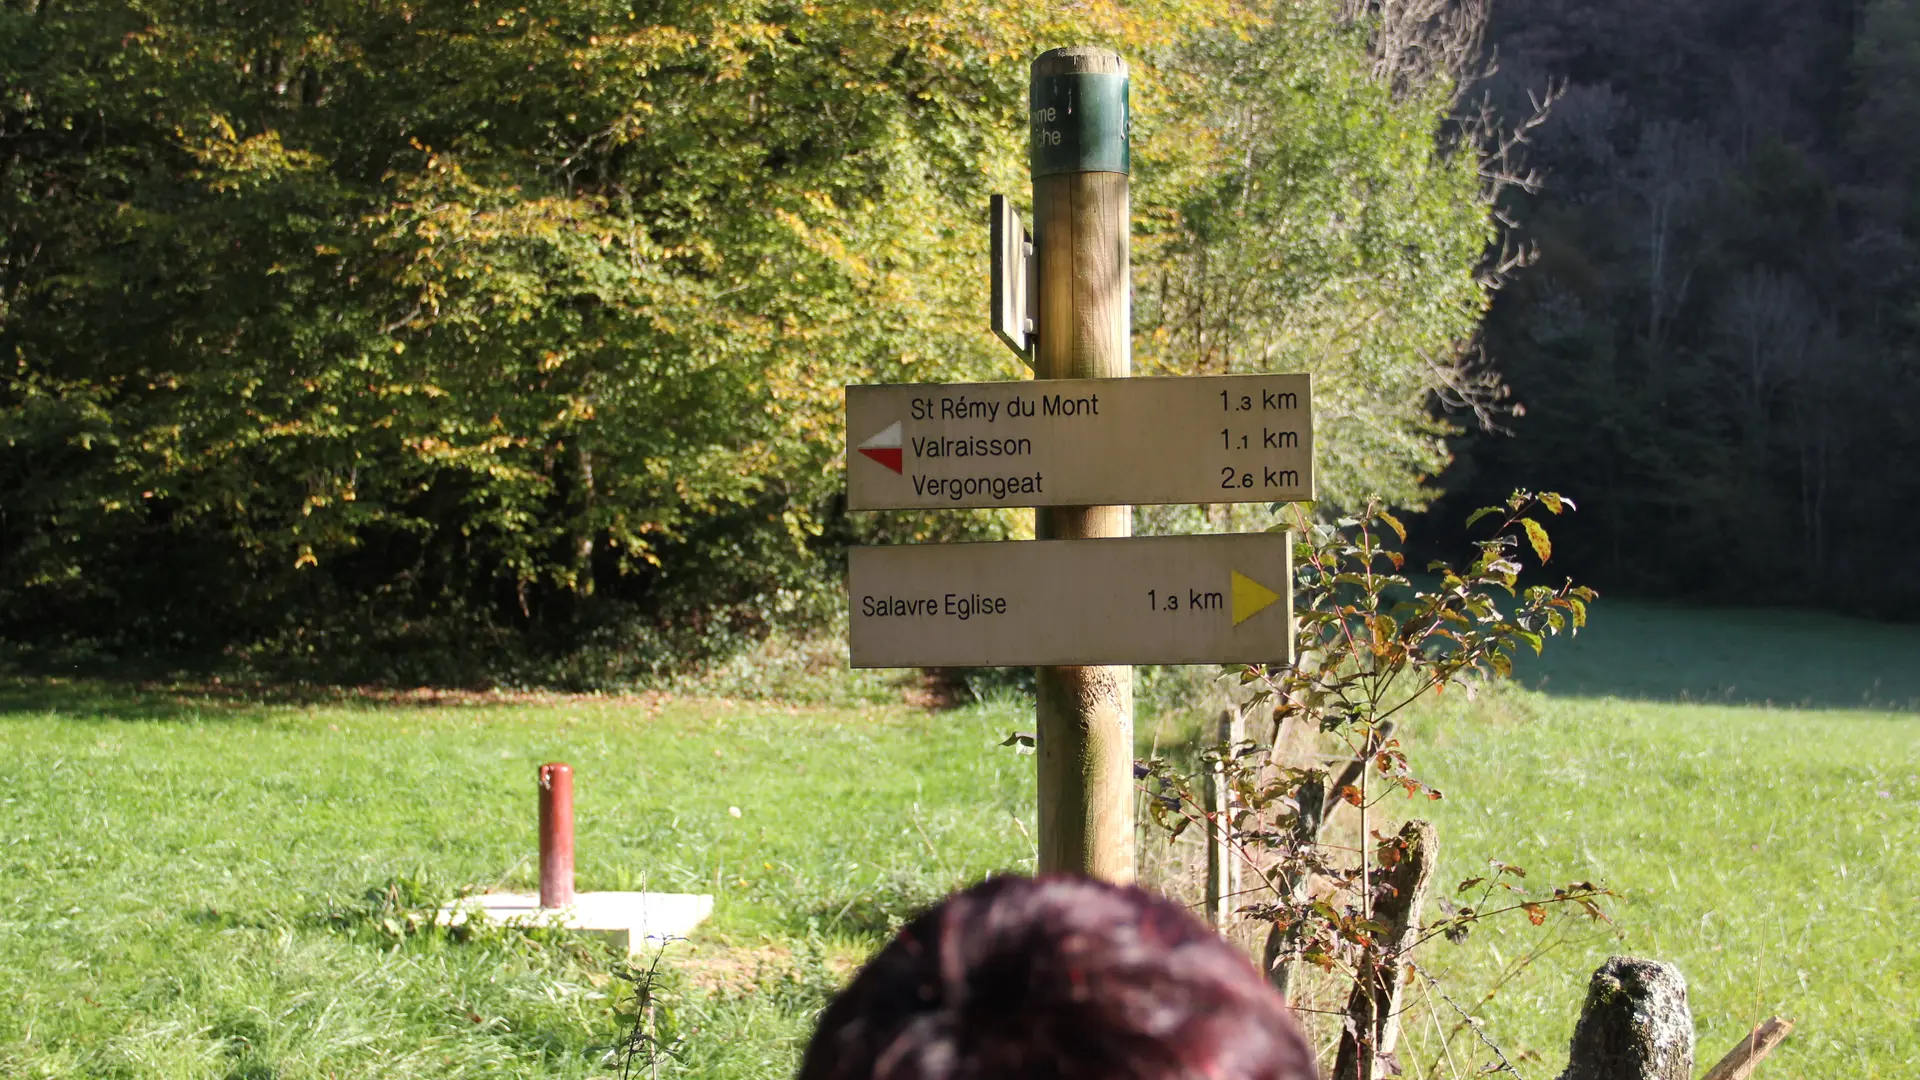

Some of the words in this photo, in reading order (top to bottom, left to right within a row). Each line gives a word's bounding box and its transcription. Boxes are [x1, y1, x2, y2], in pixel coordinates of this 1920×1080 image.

[911, 398, 934, 420] St
[941, 395, 1000, 423] Rémy
[1006, 395, 1035, 418] du
[1042, 393, 1099, 417] Mont
[1219, 389, 1252, 412] 1.3
[1262, 388, 1297, 410] km
[911, 435, 1031, 458] Valraisson
[1220, 428, 1248, 450] 1.1
[1263, 427, 1298, 449] km
[911, 471, 1043, 501] Vergongeat
[1221, 466, 1254, 489] 2.6
[1264, 465, 1299, 488] km
[862, 595, 938, 618] Salavre
[944, 594, 1007, 621] Eglise
[1147, 589, 1179, 612] 1.3
[1189, 588, 1223, 610] km
